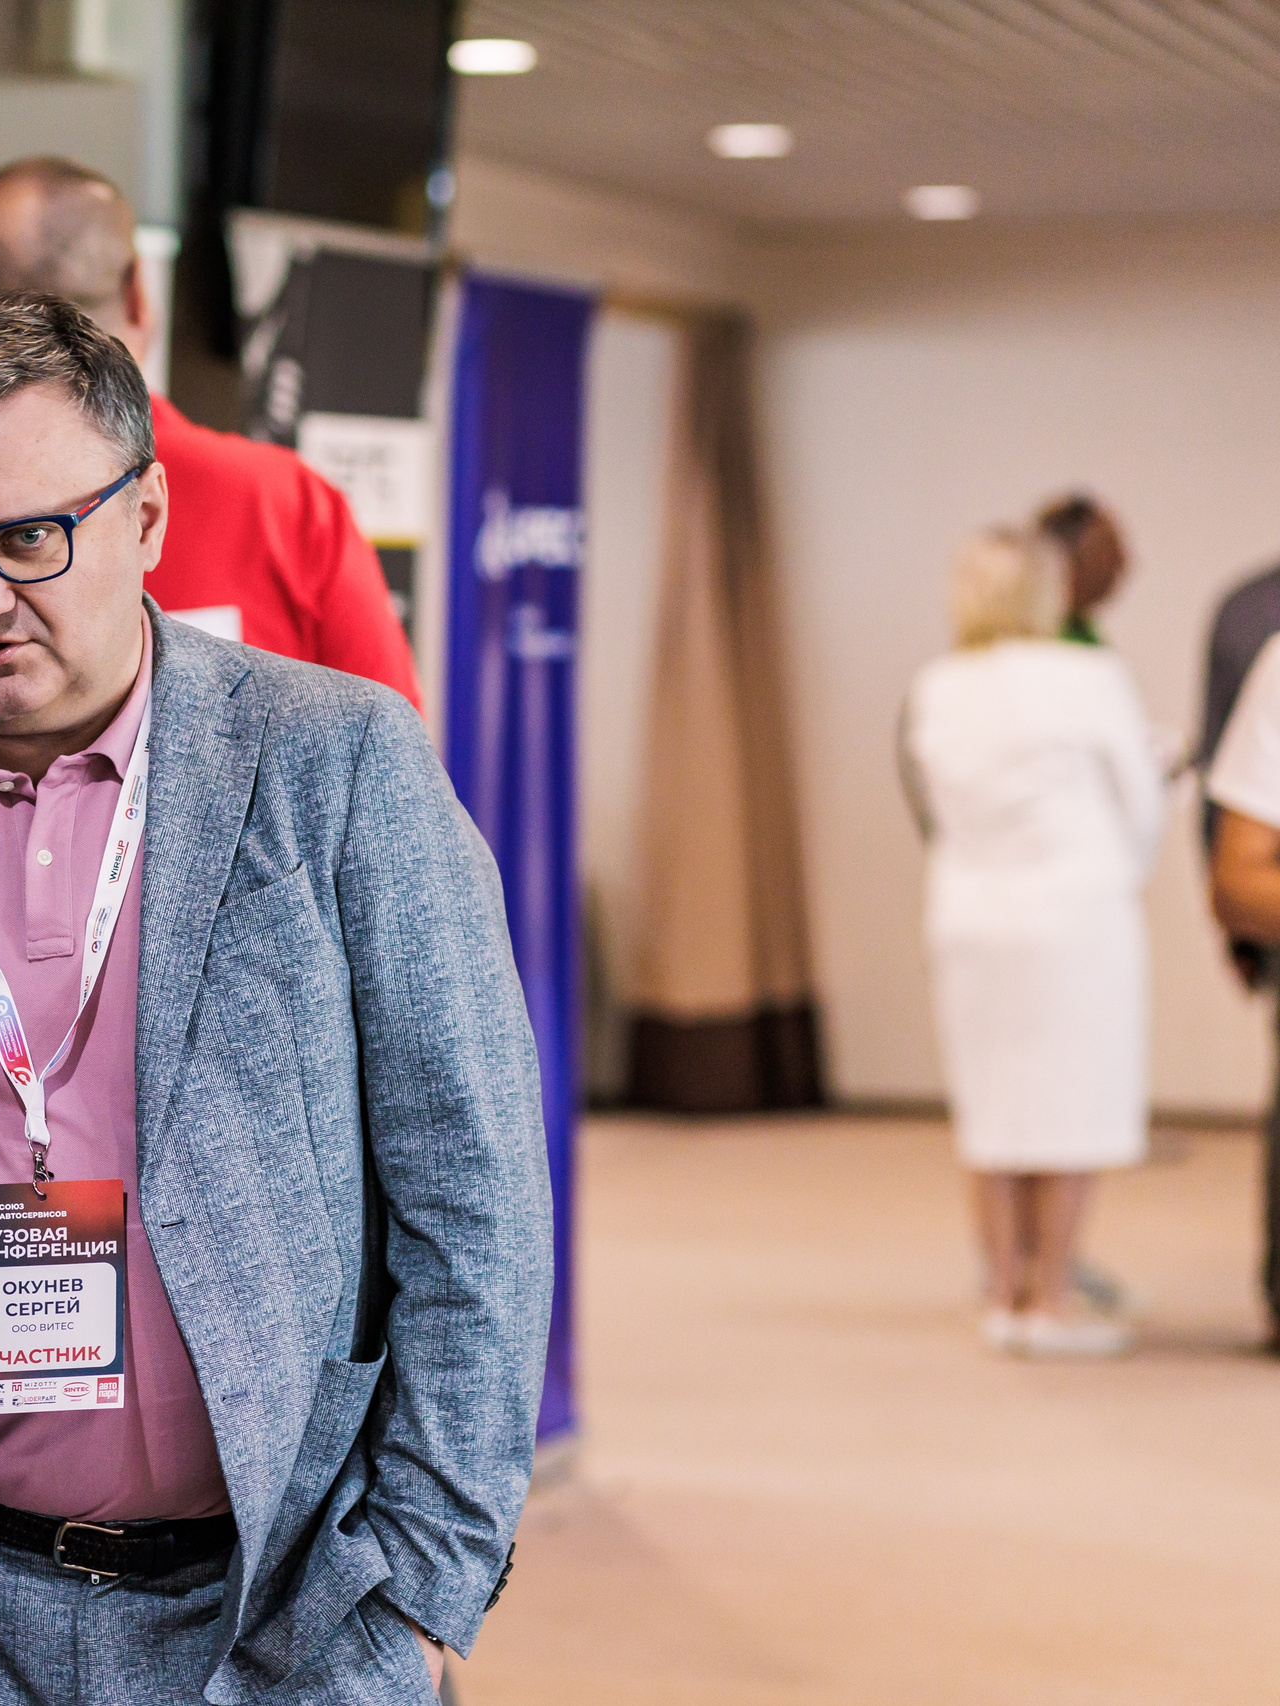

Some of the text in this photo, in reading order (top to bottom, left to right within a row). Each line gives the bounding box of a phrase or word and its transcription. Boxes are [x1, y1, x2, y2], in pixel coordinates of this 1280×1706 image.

[0, 1021, 12, 1053] АВТОСЕРВИС
[4, 1018, 20, 1057] СОВРЕМЕННЫЙ
[0, 1203, 25, 1211] СОЮЗ
[0, 1210, 67, 1220] АВТОСЕРВИСОВ
[2, 1278, 84, 1295] ОКУНЕВ
[5, 1297, 80, 1317] СЕРГЕЙ
[12, 1322, 74, 1333] ООО ВИТЕС
